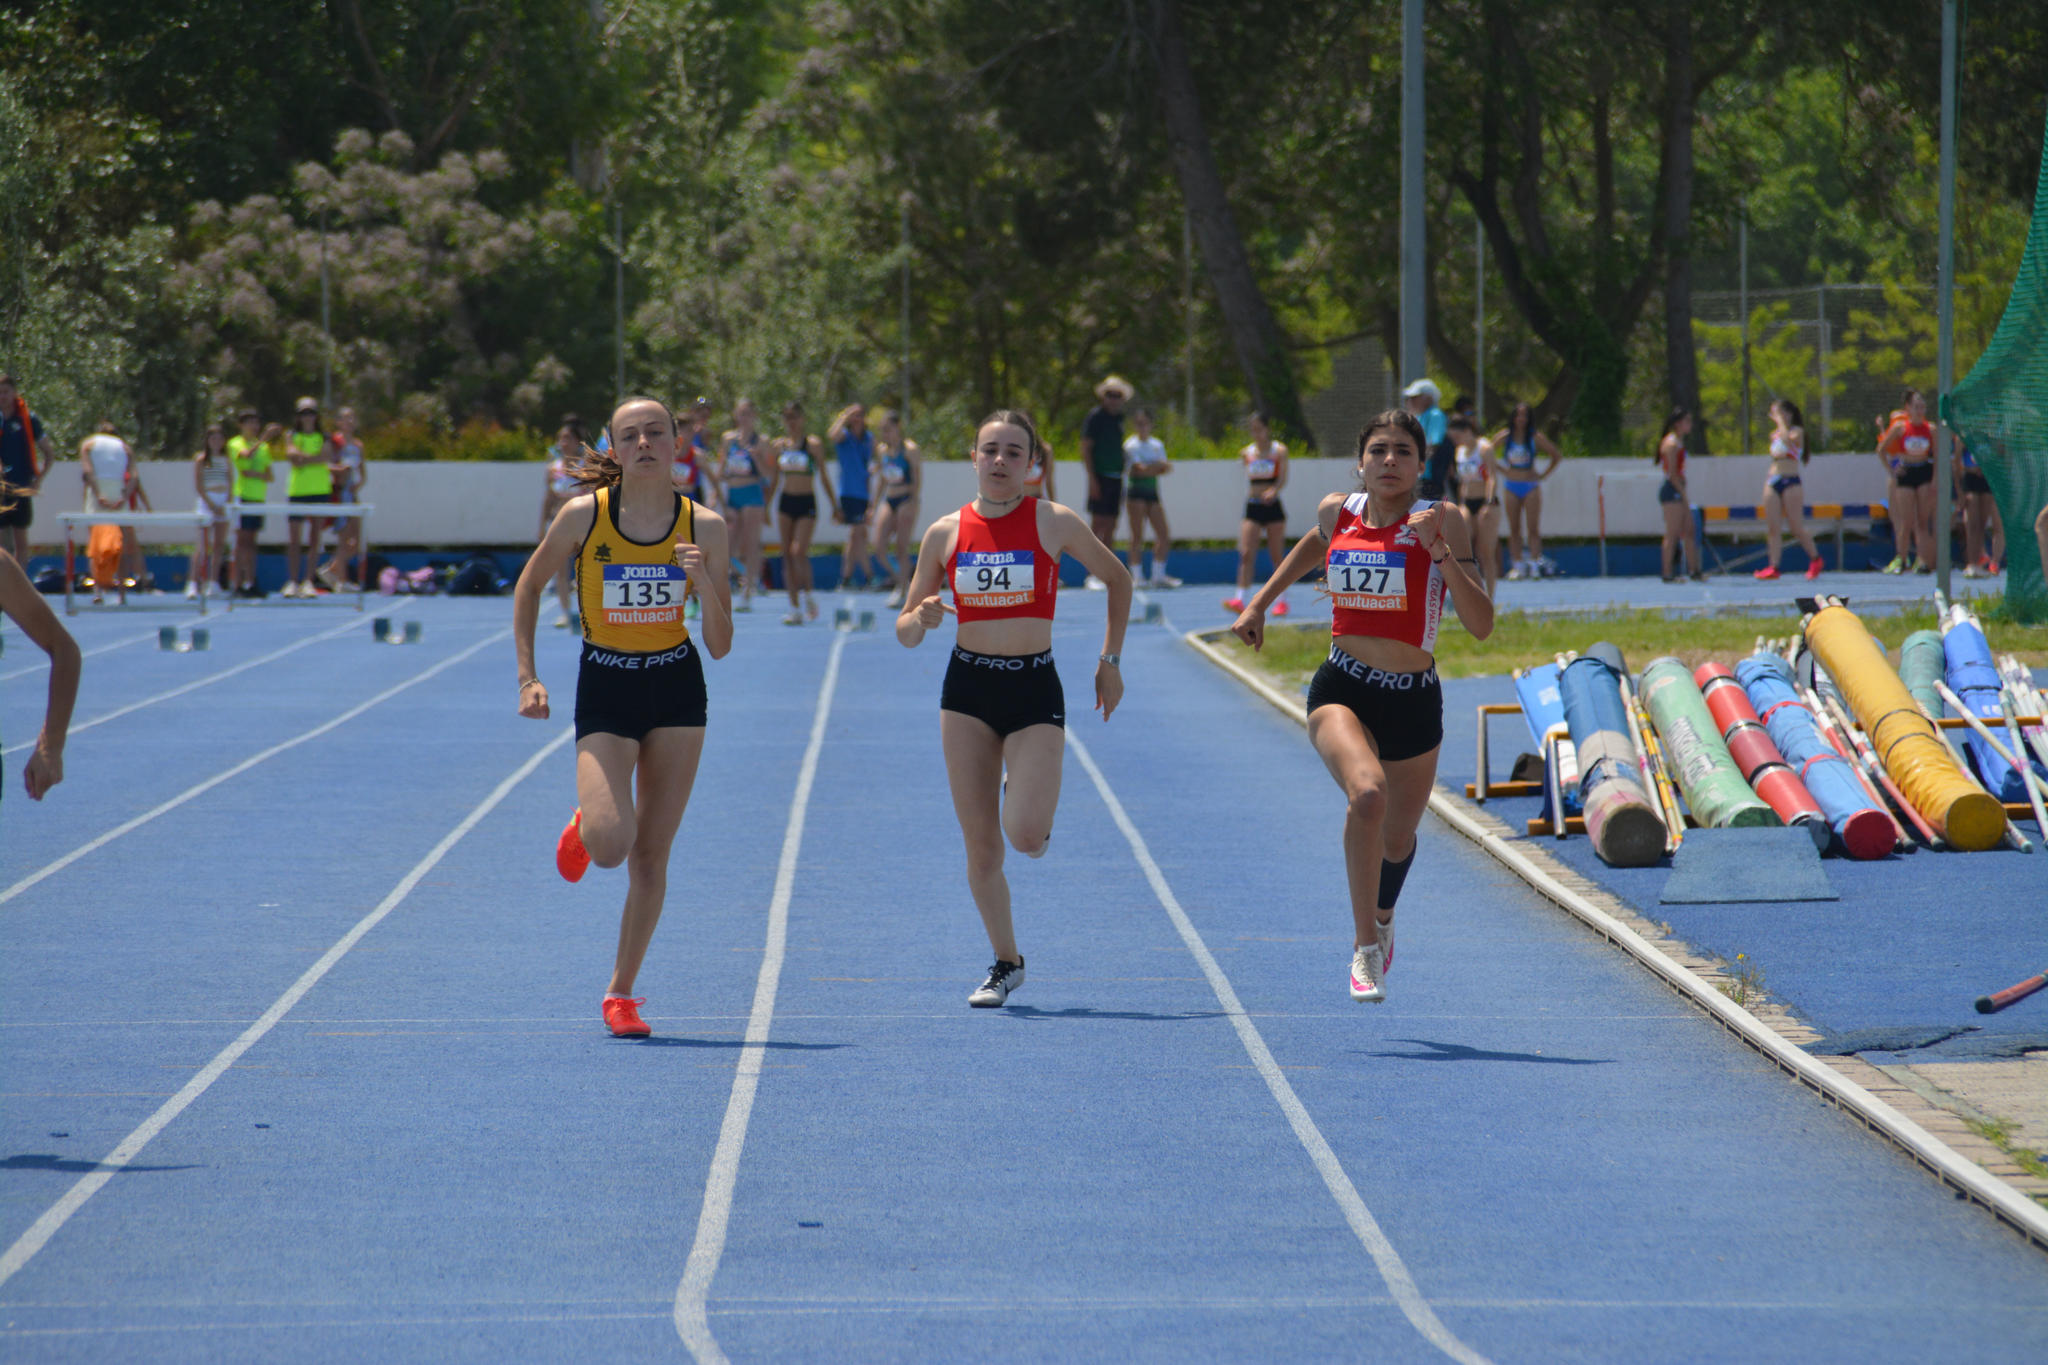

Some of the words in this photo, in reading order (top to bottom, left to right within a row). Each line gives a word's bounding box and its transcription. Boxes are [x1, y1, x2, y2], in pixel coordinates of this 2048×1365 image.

[977, 567, 1011, 591] 94
[1341, 567, 1390, 594] 127
[618, 582, 671, 607] 135
[963, 592, 1030, 606] mutuacat
[1337, 595, 1402, 609] mutuacat
[608, 608, 677, 623] mutuacat
[588, 650, 641, 669] NIKE
[644, 645, 688, 668] PRO
[974, 656, 1024, 671] PRO
[1366, 669, 1414, 690] PRO
